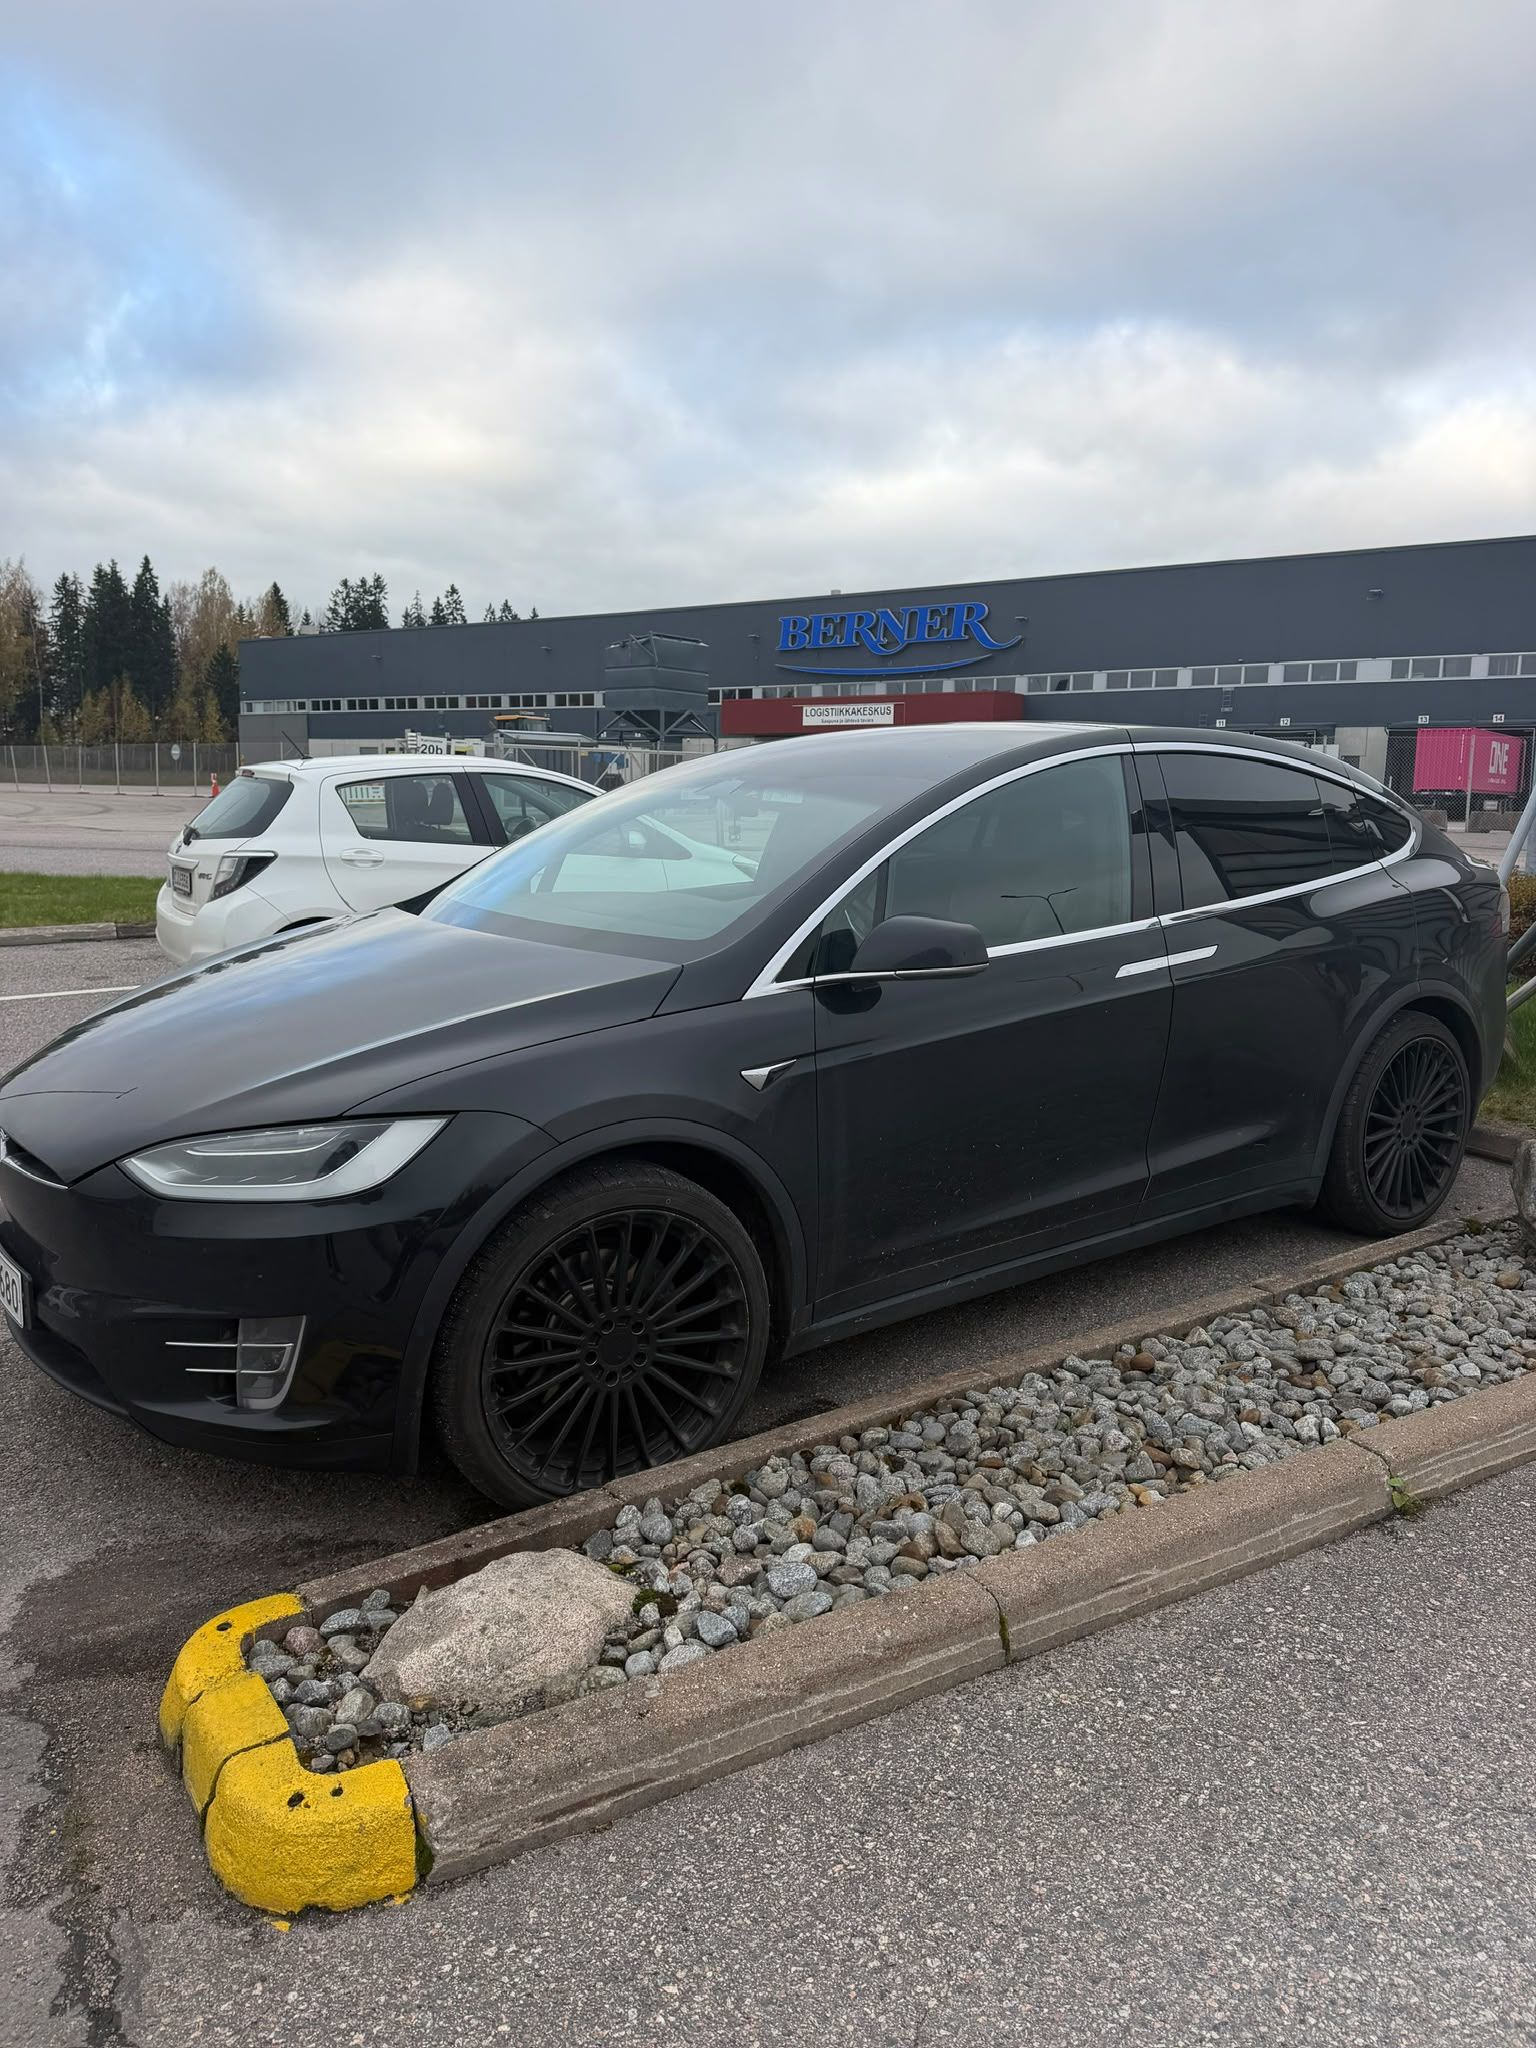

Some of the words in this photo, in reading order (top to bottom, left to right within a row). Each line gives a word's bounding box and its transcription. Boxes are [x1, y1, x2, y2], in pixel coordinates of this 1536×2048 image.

[776, 602, 1024, 655] BERNER
[805, 705, 892, 717] LOGISTIIKKAKESKUS
[421, 743, 443, 755] 20b
[1489, 741, 1509, 775] ONE
